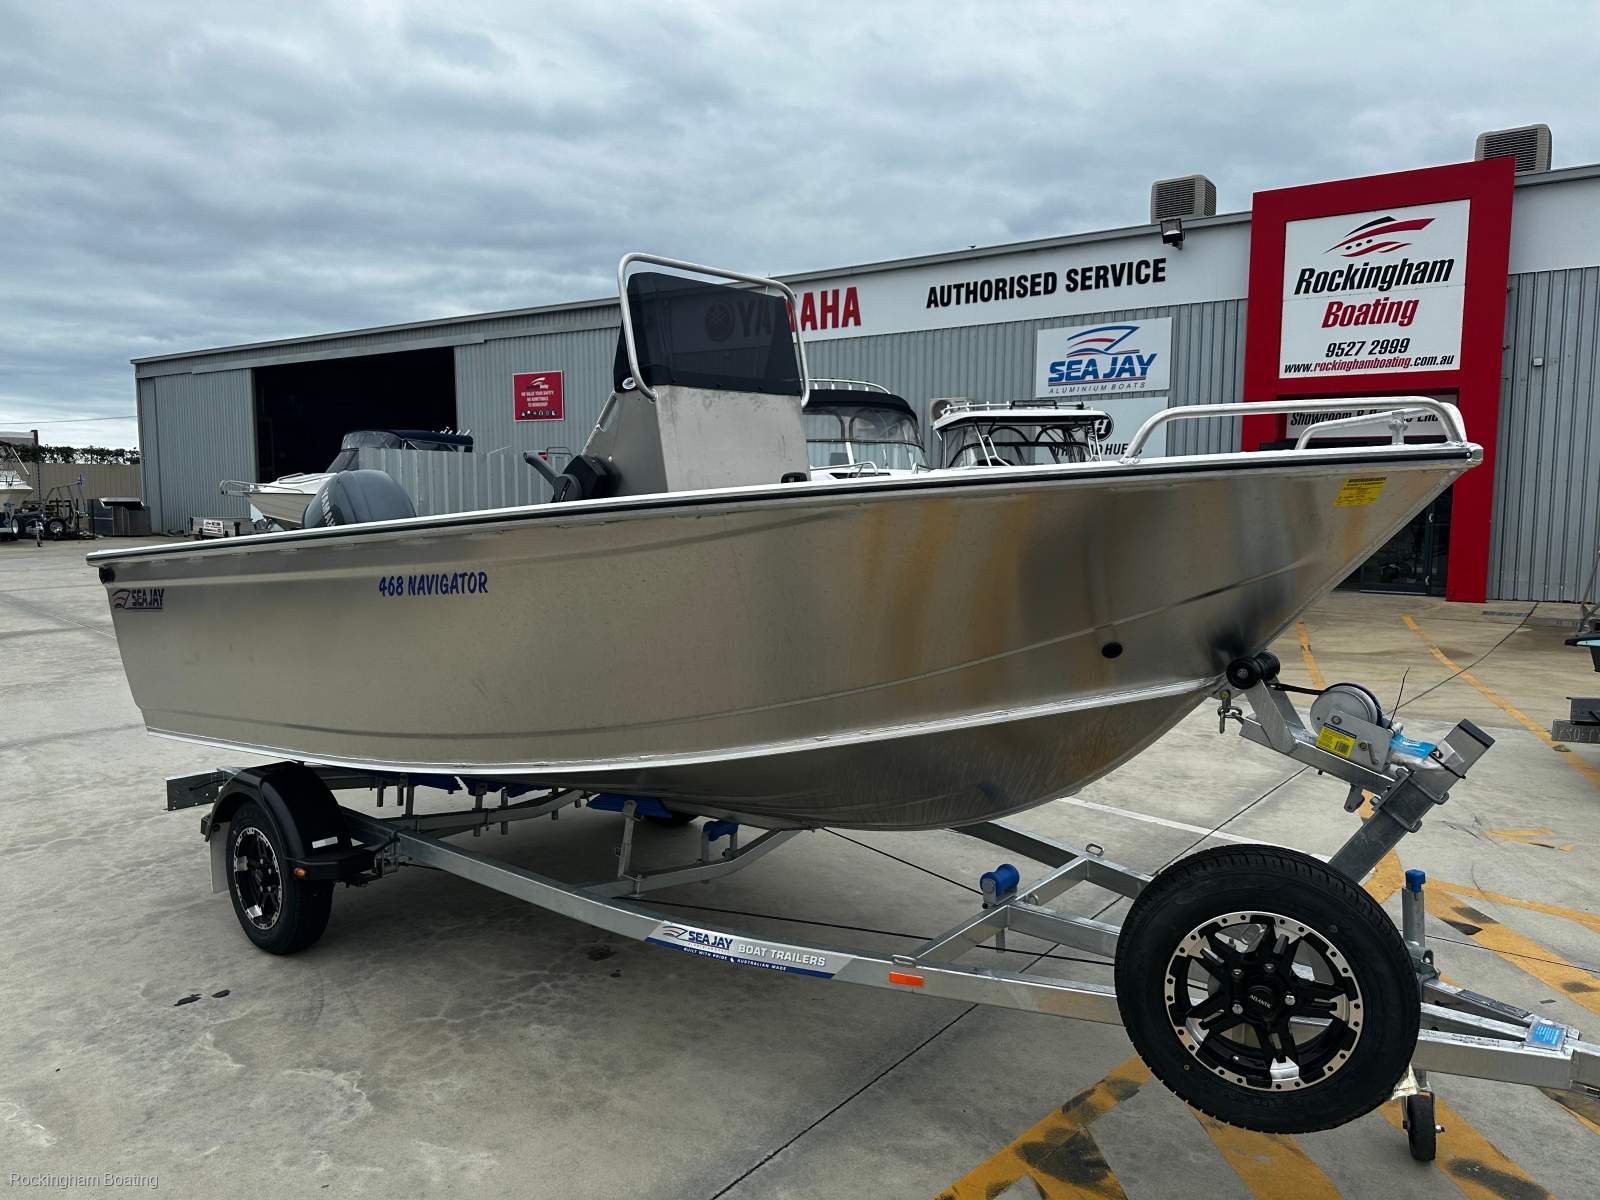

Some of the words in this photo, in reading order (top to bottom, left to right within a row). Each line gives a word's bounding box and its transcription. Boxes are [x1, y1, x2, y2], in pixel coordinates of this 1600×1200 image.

[926, 271, 1058, 308] AUTHORISED
[1065, 257, 1167, 292] SERVICE
[1294, 257, 1455, 295] Rockingham
[1321, 296, 1420, 329] Boating
[1325, 340, 1366, 358] 9527
[1368, 337, 1411, 355] 2999
[1048, 358, 1100, 382] SEA
[1103, 353, 1157, 379] JAY
[1284, 354, 1455, 374] www.rockinghamboating.com.au
[1049, 384, 1107, 395] ALUMINIUM
[1111, 381, 1146, 391] BOATS
[321, 487, 336, 527] YAMAH
[131, 588, 148, 607] SEA
[149, 587, 165, 607] JAY
[378, 575, 404, 597] 468
[408, 571, 488, 596] NAVIGATOR
[688, 930, 710, 945] SEA
[710, 935, 733, 949] JAY
[738, 944, 767, 957] BOAT
[770, 949, 826, 967] TRAILERS
